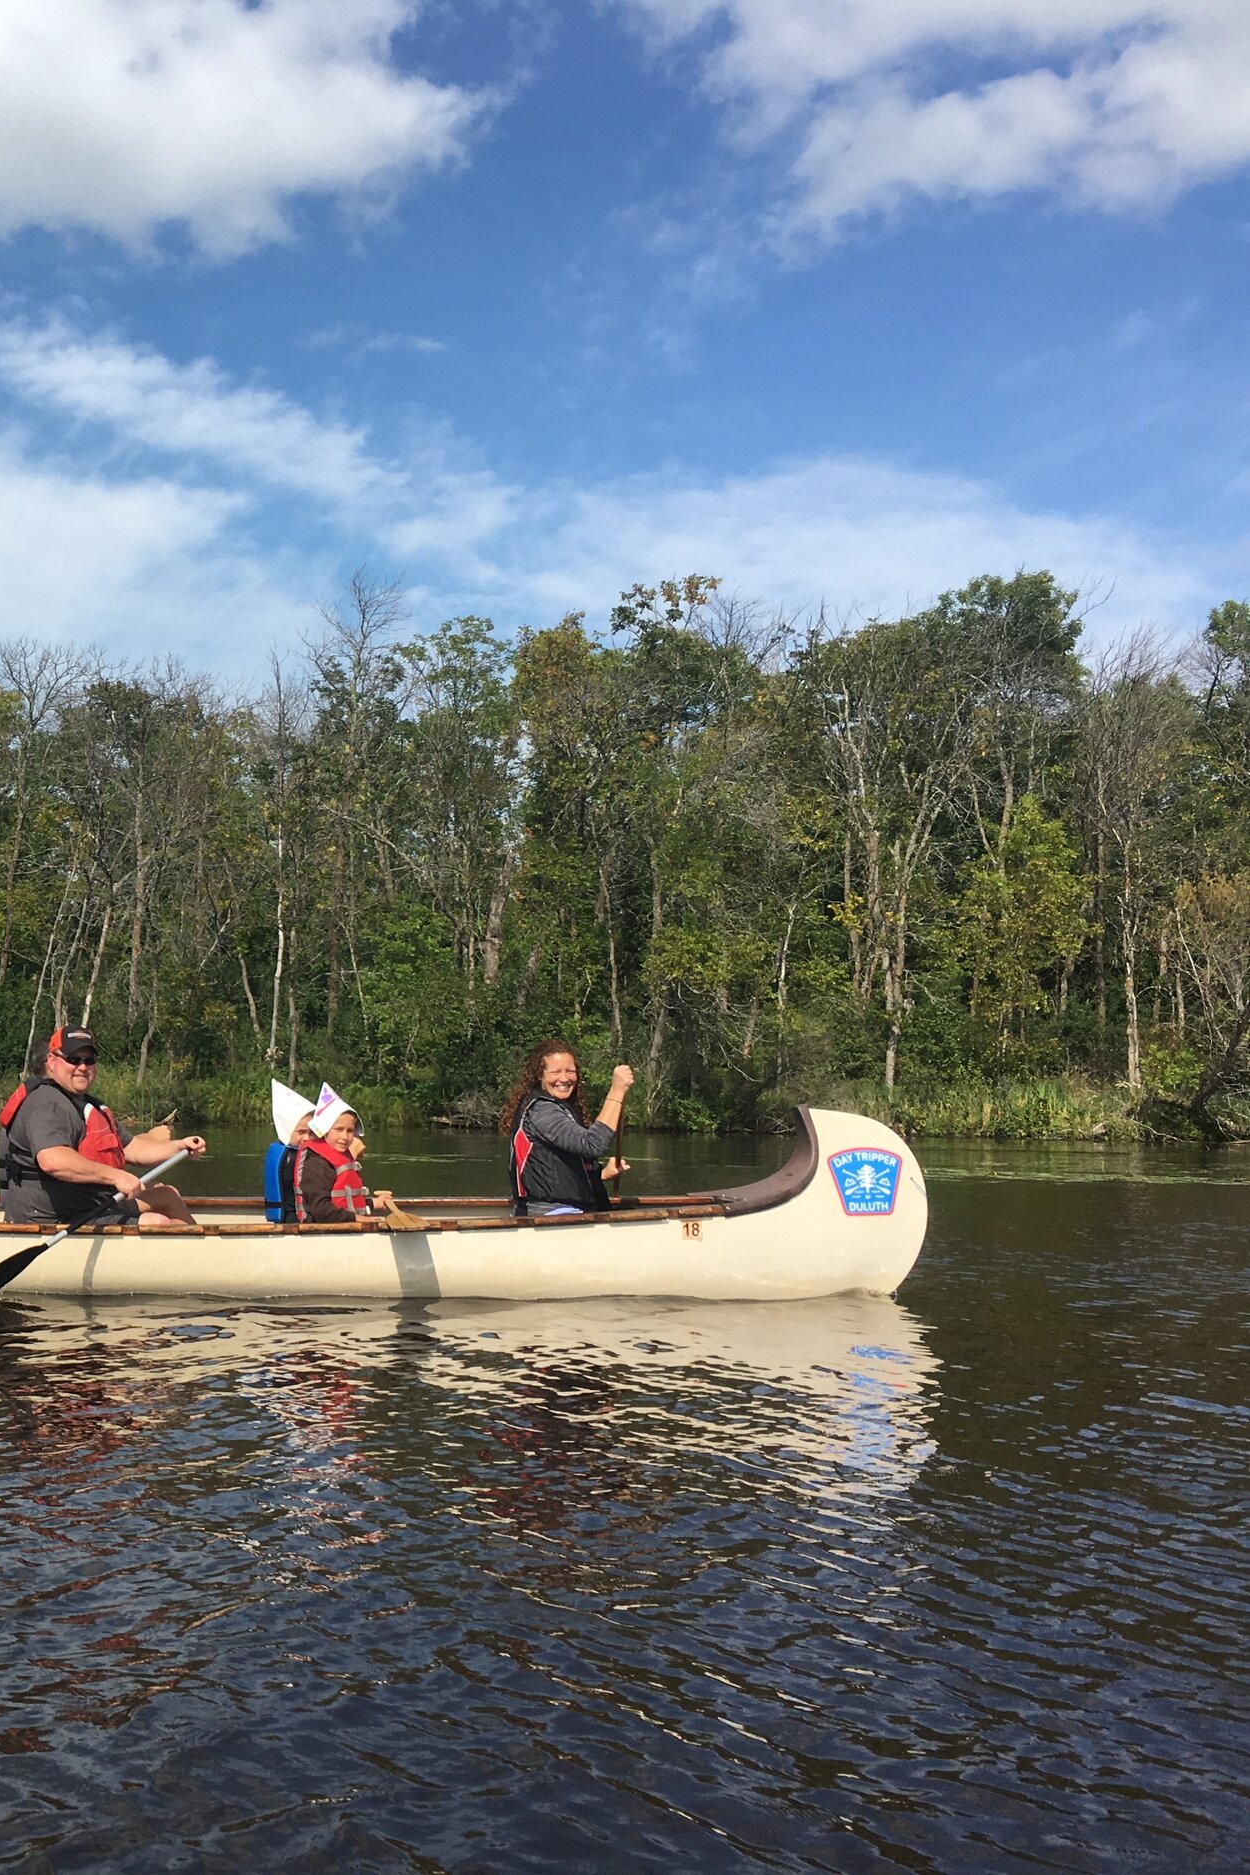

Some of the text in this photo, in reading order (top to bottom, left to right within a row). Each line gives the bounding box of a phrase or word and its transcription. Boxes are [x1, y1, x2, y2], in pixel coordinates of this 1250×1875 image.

[833, 1151, 897, 1168] DAY TRIPPER
[848, 1201, 889, 1212] DULUTH
[682, 1222, 700, 1237] 18
